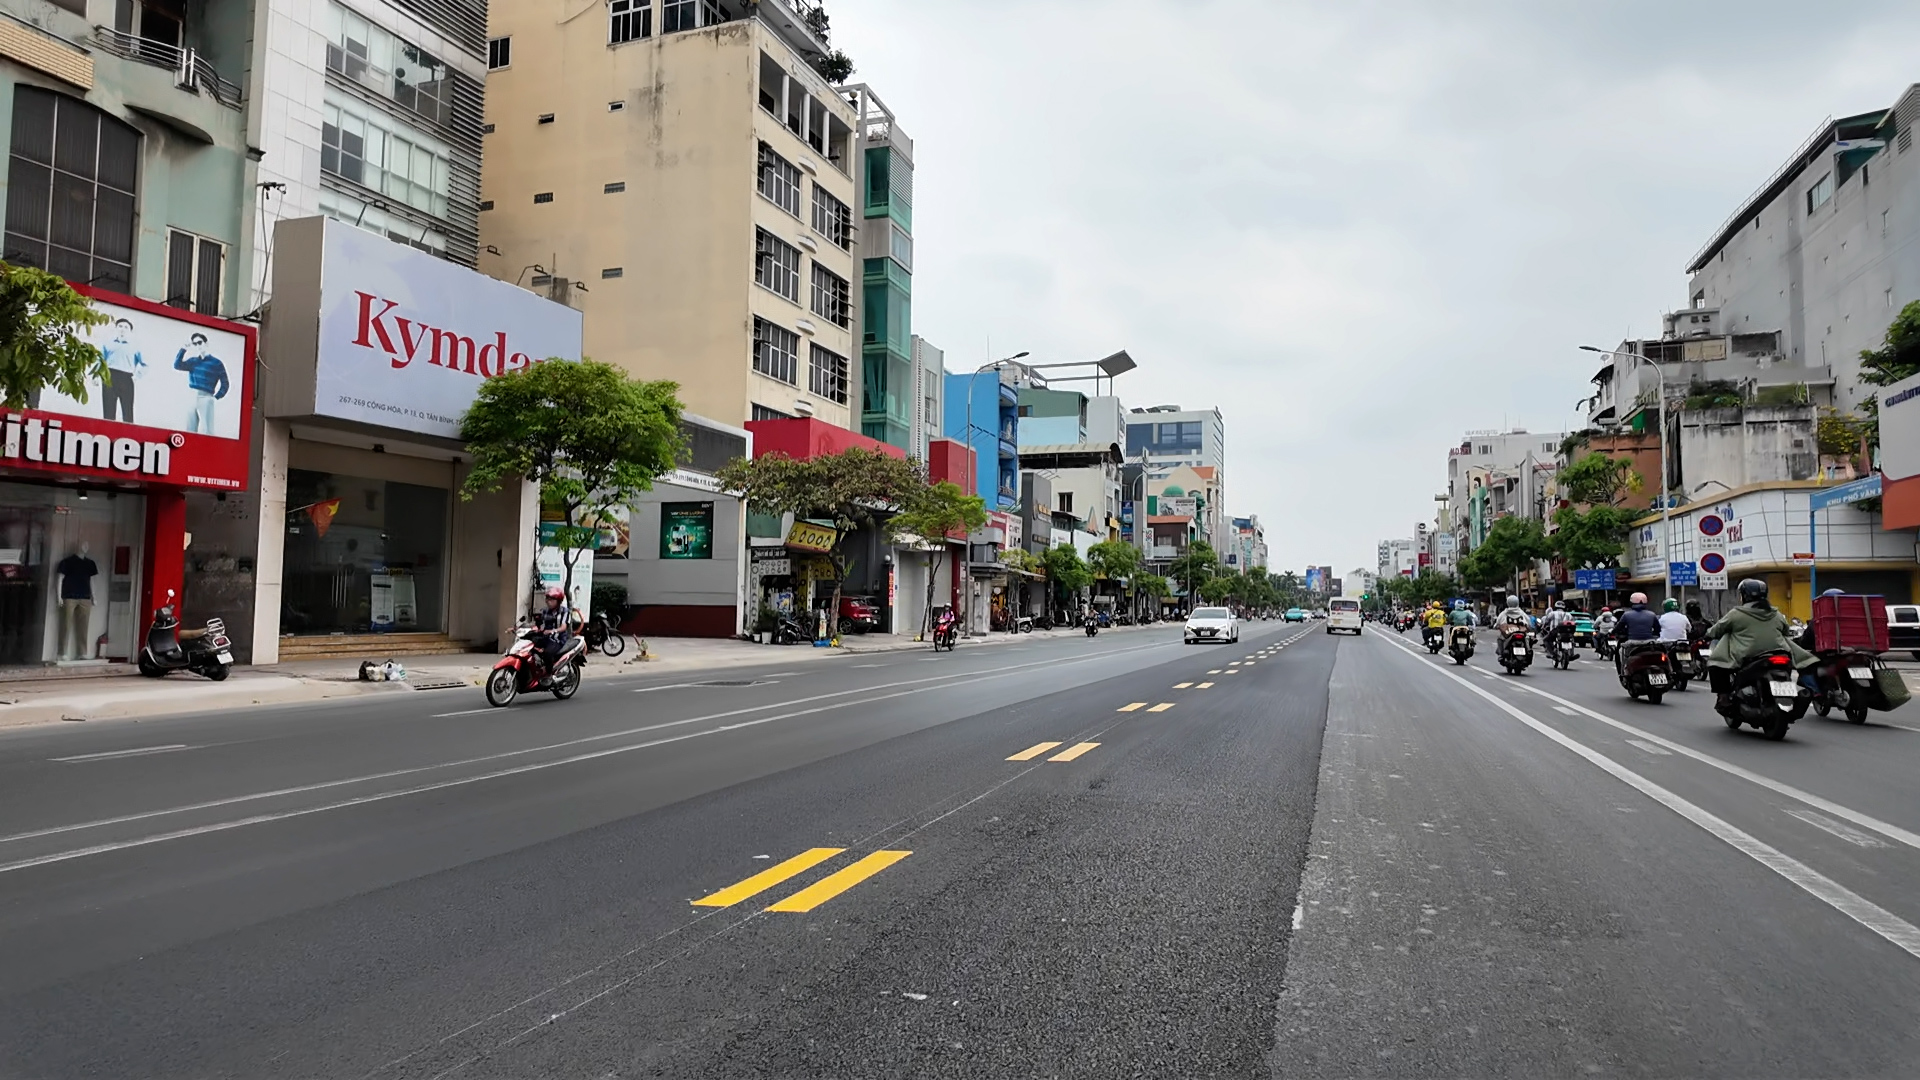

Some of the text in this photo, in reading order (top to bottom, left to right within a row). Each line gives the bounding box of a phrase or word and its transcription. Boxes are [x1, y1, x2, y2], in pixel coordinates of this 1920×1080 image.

[352, 290, 546, 378] Kymda
[339, 395, 365, 407] 267-269
[0, 413, 170, 475] itimen
[1826, 497, 1841, 506] KHU
[1842, 489, 1858, 503] PHỐ
